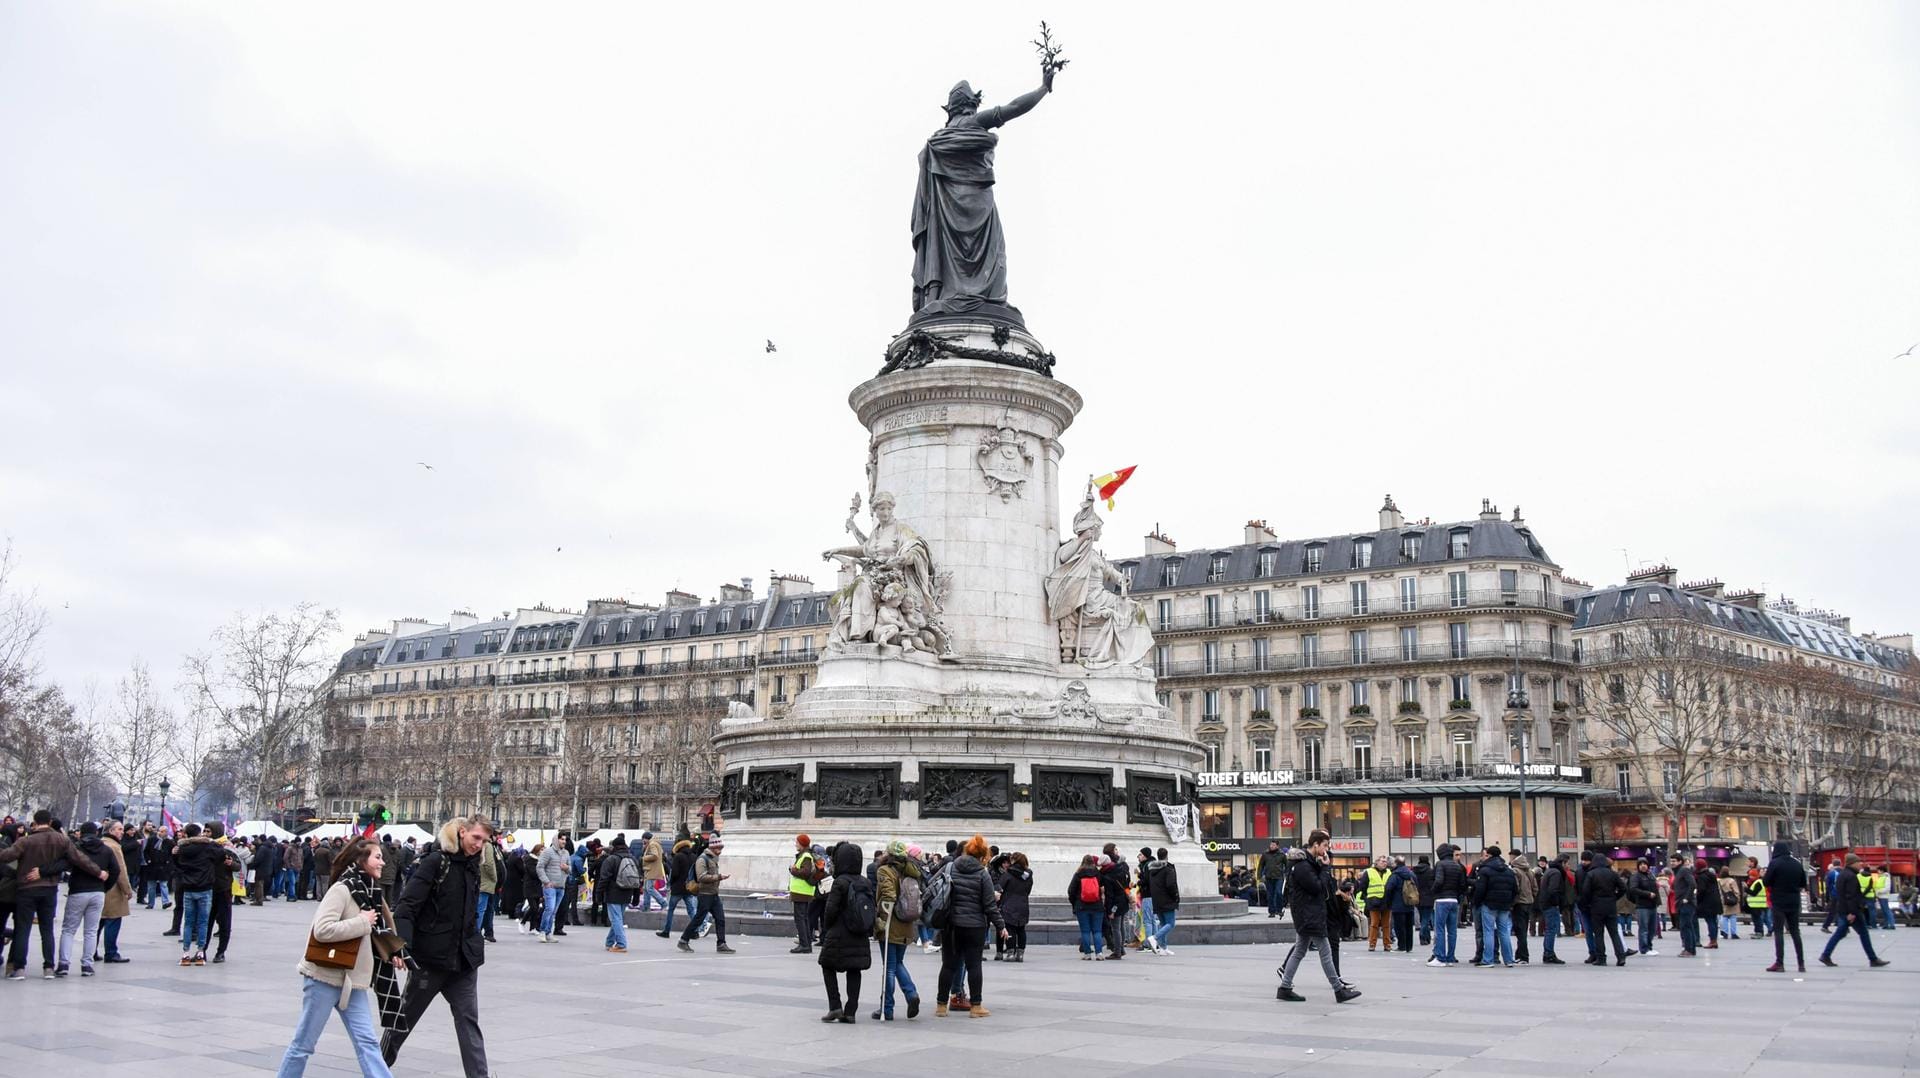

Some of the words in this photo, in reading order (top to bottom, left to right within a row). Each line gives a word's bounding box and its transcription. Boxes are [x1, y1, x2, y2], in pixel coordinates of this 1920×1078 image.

[941, 743, 980, 753] PRAIRAL
[1496, 764, 1521, 775] WAL
[1524, 764, 1556, 775] STREET
[1198, 772, 1239, 786] STREET
[1243, 770, 1294, 785] ENGLISH
